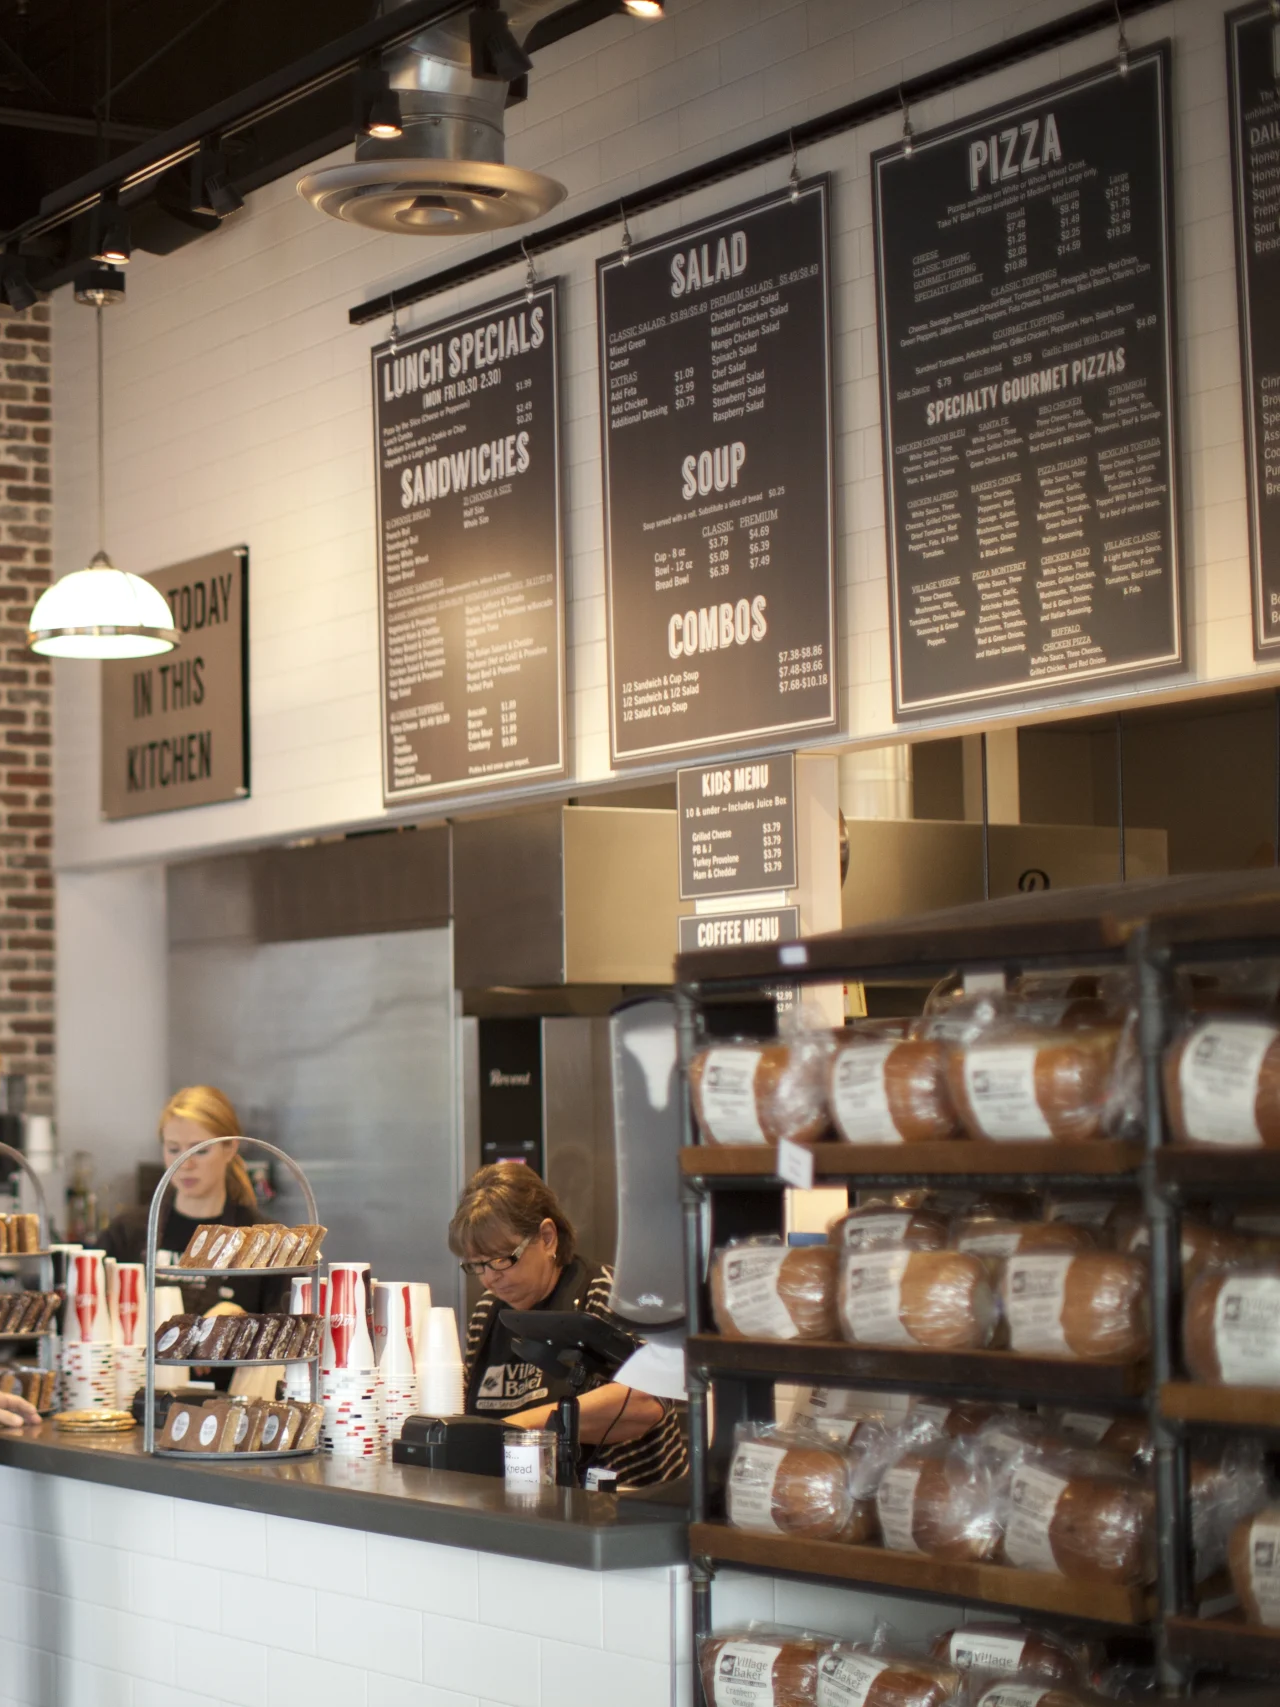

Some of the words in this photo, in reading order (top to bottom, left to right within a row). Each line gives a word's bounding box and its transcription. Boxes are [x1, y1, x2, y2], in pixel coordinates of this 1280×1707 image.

[970, 113, 1061, 192] PIZZA
[1006, 207, 1025, 221] Small
[1052, 190, 1079, 205] Medium
[1109, 172, 1129, 185] Large
[912, 250, 939, 265] CHEESE
[1007, 220, 1025, 233] $7.49
[671, 230, 747, 298] SALAD
[913, 262, 940, 278] CLASSIC
[941, 252, 971, 269] TOPPING
[914, 273, 946, 290] GOURMET
[948, 263, 976, 280] TOPPING
[914, 285, 949, 303] SPECIALTY
[950, 273, 984, 291] GOURMET
[609, 324, 637, 344] CLASSIC
[638, 316, 666, 337] SALADS
[710, 289, 744, 310] PREMIUM
[744, 279, 773, 297] SALADS
[710, 308, 736, 323] Chicken
[737, 301, 759, 314] Caesar
[760, 292, 779, 306] Salad
[711, 320, 741, 337] Mandarin
[742, 312, 768, 327] Chicken
[770, 303, 789, 318] Salad
[610, 343, 627, 356] Mixed
[628, 338, 646, 351] Green
[711, 337, 733, 352] Mango
[734, 329, 759, 344] Chicken
[761, 321, 780, 335] Salad
[384, 343, 443, 402] LUNCH
[448, 306, 544, 378] SPECIALS
[610, 358, 629, 371] Caesar
[712, 349, 737, 366] Spinach
[739, 343, 757, 357] Salad
[712, 366, 727, 380] Chef
[728, 360, 746, 374] Salad
[611, 372, 638, 389] EXTRAS
[611, 390, 623, 402] Add
[624, 386, 637, 399] Feta
[674, 367, 694, 382] $1.09
[712, 376, 745, 393] Southwest
[746, 369, 765, 383] Salad
[713, 391, 746, 408] Strawberry
[747, 384, 766, 397] Salad
[926, 384, 999, 426] SPECIALTY
[1001, 363, 1069, 405] GOURMET
[1072, 347, 1126, 383] PIZZAS
[611, 404, 623, 416] Add
[624, 397, 648, 412] Chicken
[675, 381, 695, 396] $2.99
[612, 412, 641, 429] Additional
[642, 404, 668, 421] Dressing
[675, 395, 695, 410] $0.79
[713, 405, 744, 422] Raspberry
[746, 399, 764, 413] Salad
[401, 431, 529, 509] SANDWICHES
[682, 441, 746, 500] SOUP
[643, 520, 655, 532] Soup
[698, 503, 724, 517] Substitute
[748, 492, 763, 504] bread
[768, 486, 785, 499] $0.25
[702, 520, 735, 538] CLASSIC
[739, 509, 778, 528] PREMIUM
[654, 552, 666, 564] Cup
[708, 536, 729, 550] $3.79
[749, 525, 770, 539] $4.69
[655, 565, 669, 577] Bowl
[709, 550, 729, 564] $5.09
[749, 540, 770, 554] $6.39
[655, 577, 673, 591] Bread
[674, 574, 689, 586] Bowl
[709, 565, 729, 578] $6.39
[750, 555, 770, 569] $7.49
[167, 573, 232, 633] TODAY
[668, 594, 767, 659] COMBOS
[622, 683, 633, 694] 1/2
[634, 675, 662, 691] Sandwich
[670, 674, 682, 686] Cup
[683, 670, 699, 683] Soup
[778, 645, 823, 664] $7.38-$8.86
[623, 696, 633, 708] 1/2
[634, 690, 662, 705] Sandwich
[670, 687, 680, 699] 1/2
[682, 684, 699, 697] Salad
[779, 660, 823, 678] $7.48-$9.66
[133, 669, 152, 719] IN
[159, 656, 204, 713] THIS
[623, 710, 634, 722] 1/2
[635, 706, 651, 719] Salad
[659, 703, 670, 715] Cup
[672, 701, 688, 714] Soup
[127, 730, 212, 794] KITCHEN
[702, 770, 732, 797] KIDS
[734, 764, 769, 793] MENU
[686, 807, 694, 818] 10
[702, 805, 721, 816] under
[728, 800, 755, 813] Includes
[756, 798, 773, 809] Juice
[775, 796, 787, 806] Box
[692, 831, 711, 842] Grilled
[712, 829, 732, 840] Cheese
[763, 822, 781, 834] $3.79
[693, 845, 701, 855] PB
[763, 835, 781, 847] $3.79
[693, 857, 711, 868] Turkey
[713, 854, 739, 866] Provolone
[763, 849, 781, 860] $3.79
[693, 870, 707, 880] Ham
[713, 867, 737, 877] Cheddar
[764, 861, 782, 873] $3.79
[697, 920, 741, 948] COFFEE
[743, 916, 779, 944] MENU
[734, 1667, 762, 1681] Baker
[737, 1657, 768, 1671] Village
[835, 1671, 862, 1688] Baker
[725, 1687, 758, 1699] Cranberry
